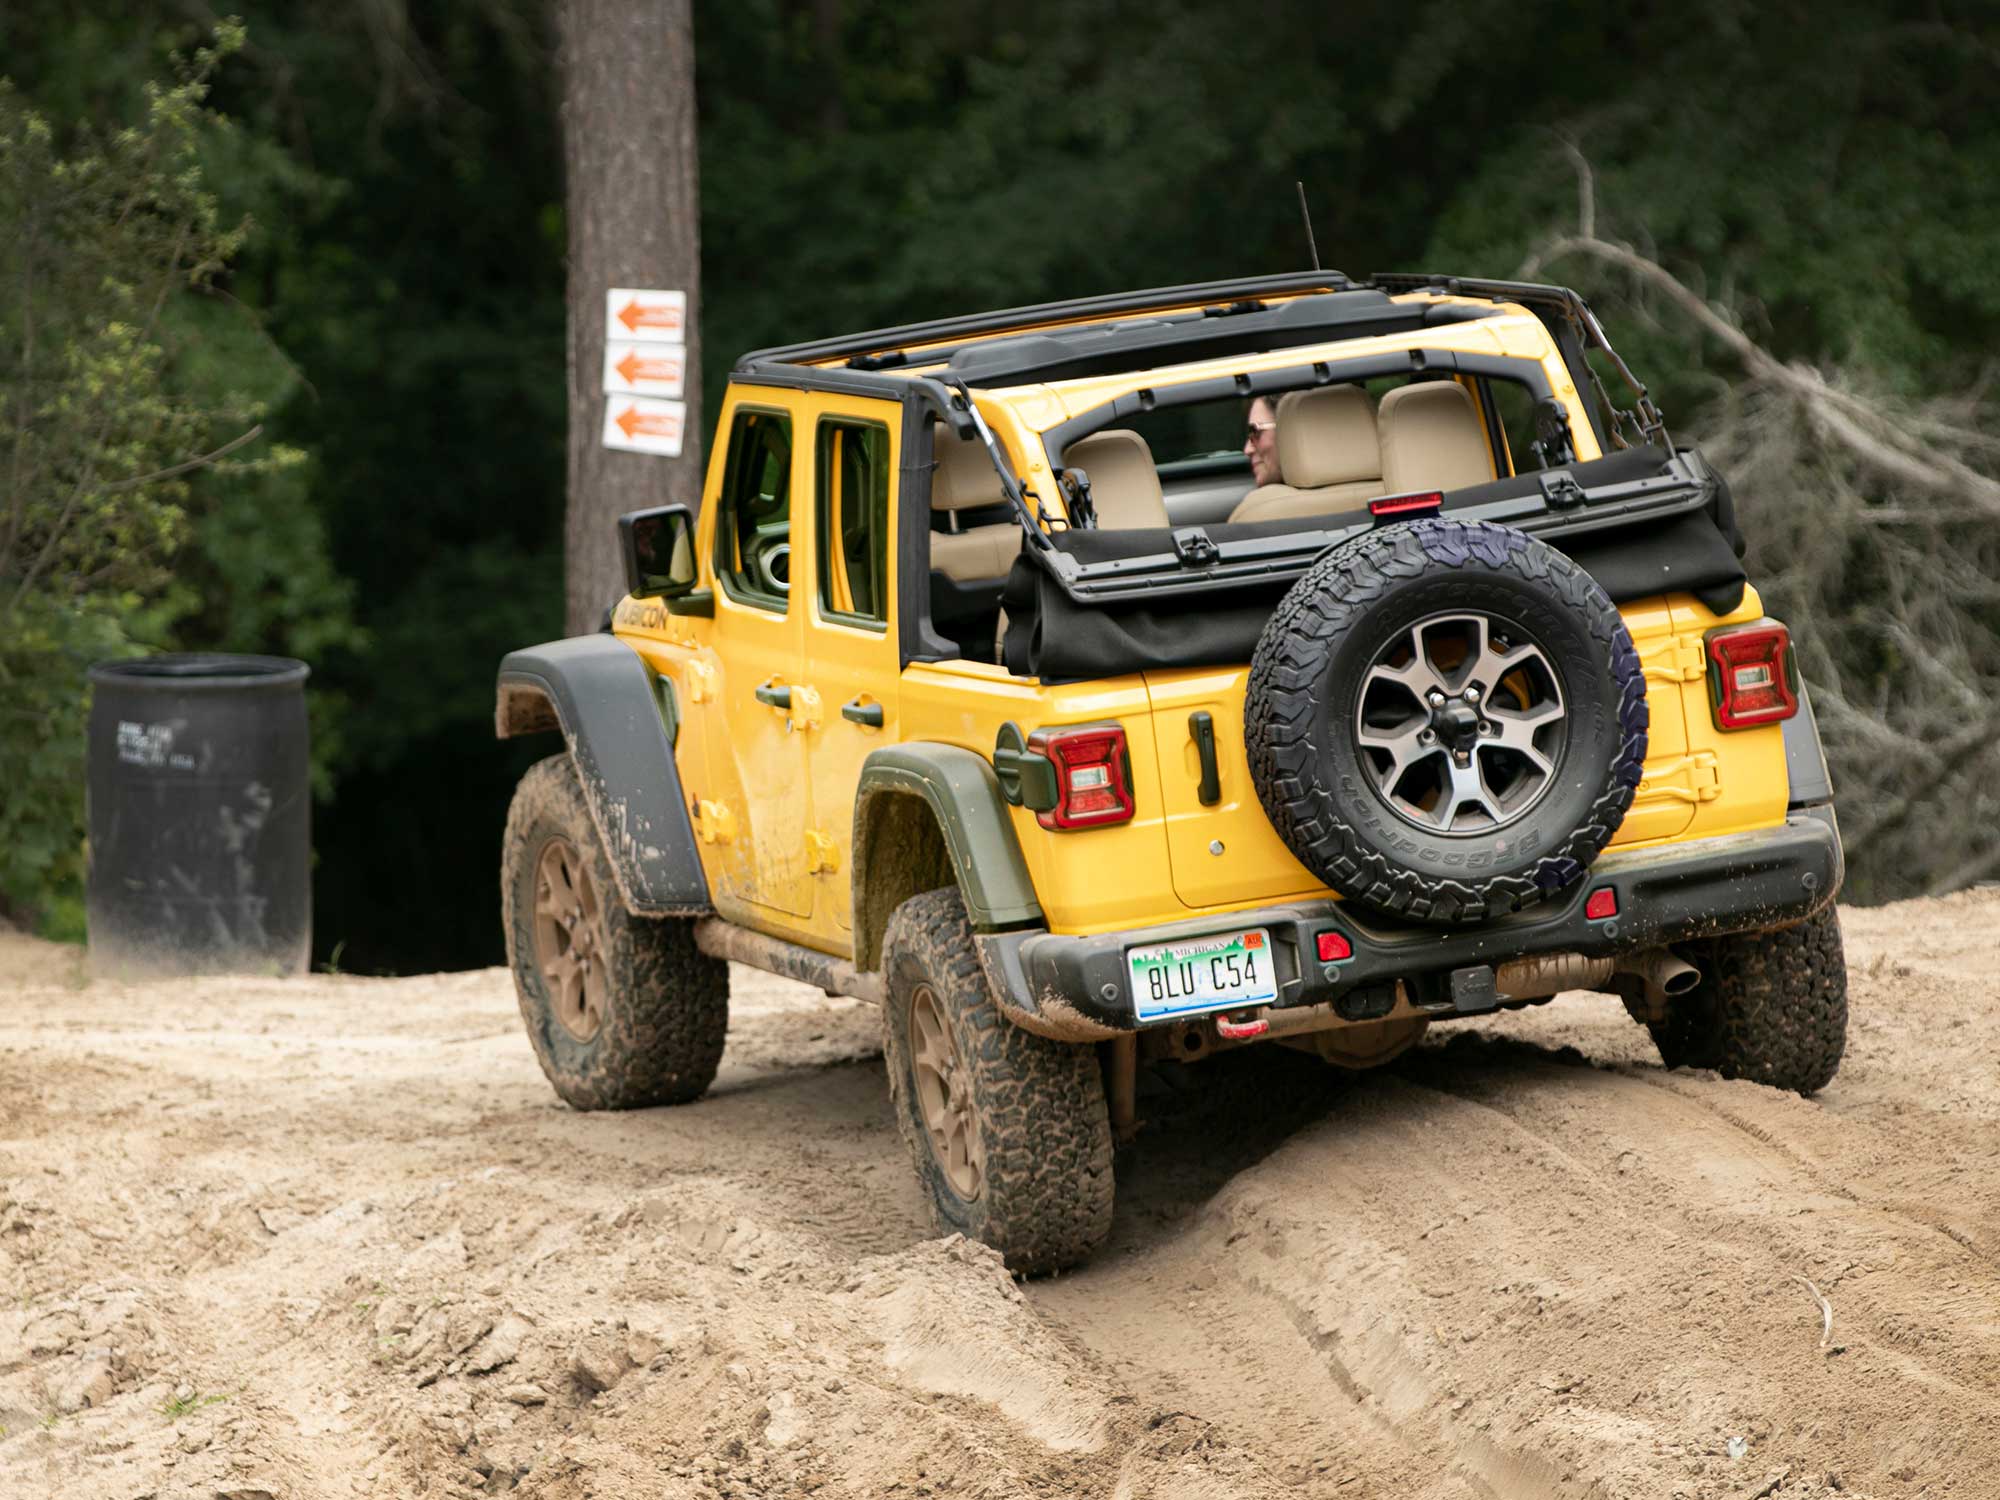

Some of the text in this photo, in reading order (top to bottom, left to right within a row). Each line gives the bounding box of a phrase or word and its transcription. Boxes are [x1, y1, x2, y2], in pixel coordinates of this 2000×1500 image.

[1176, 943, 1225, 957] MICHIGAN
[1149, 952, 1256, 1000] 8LU C54
